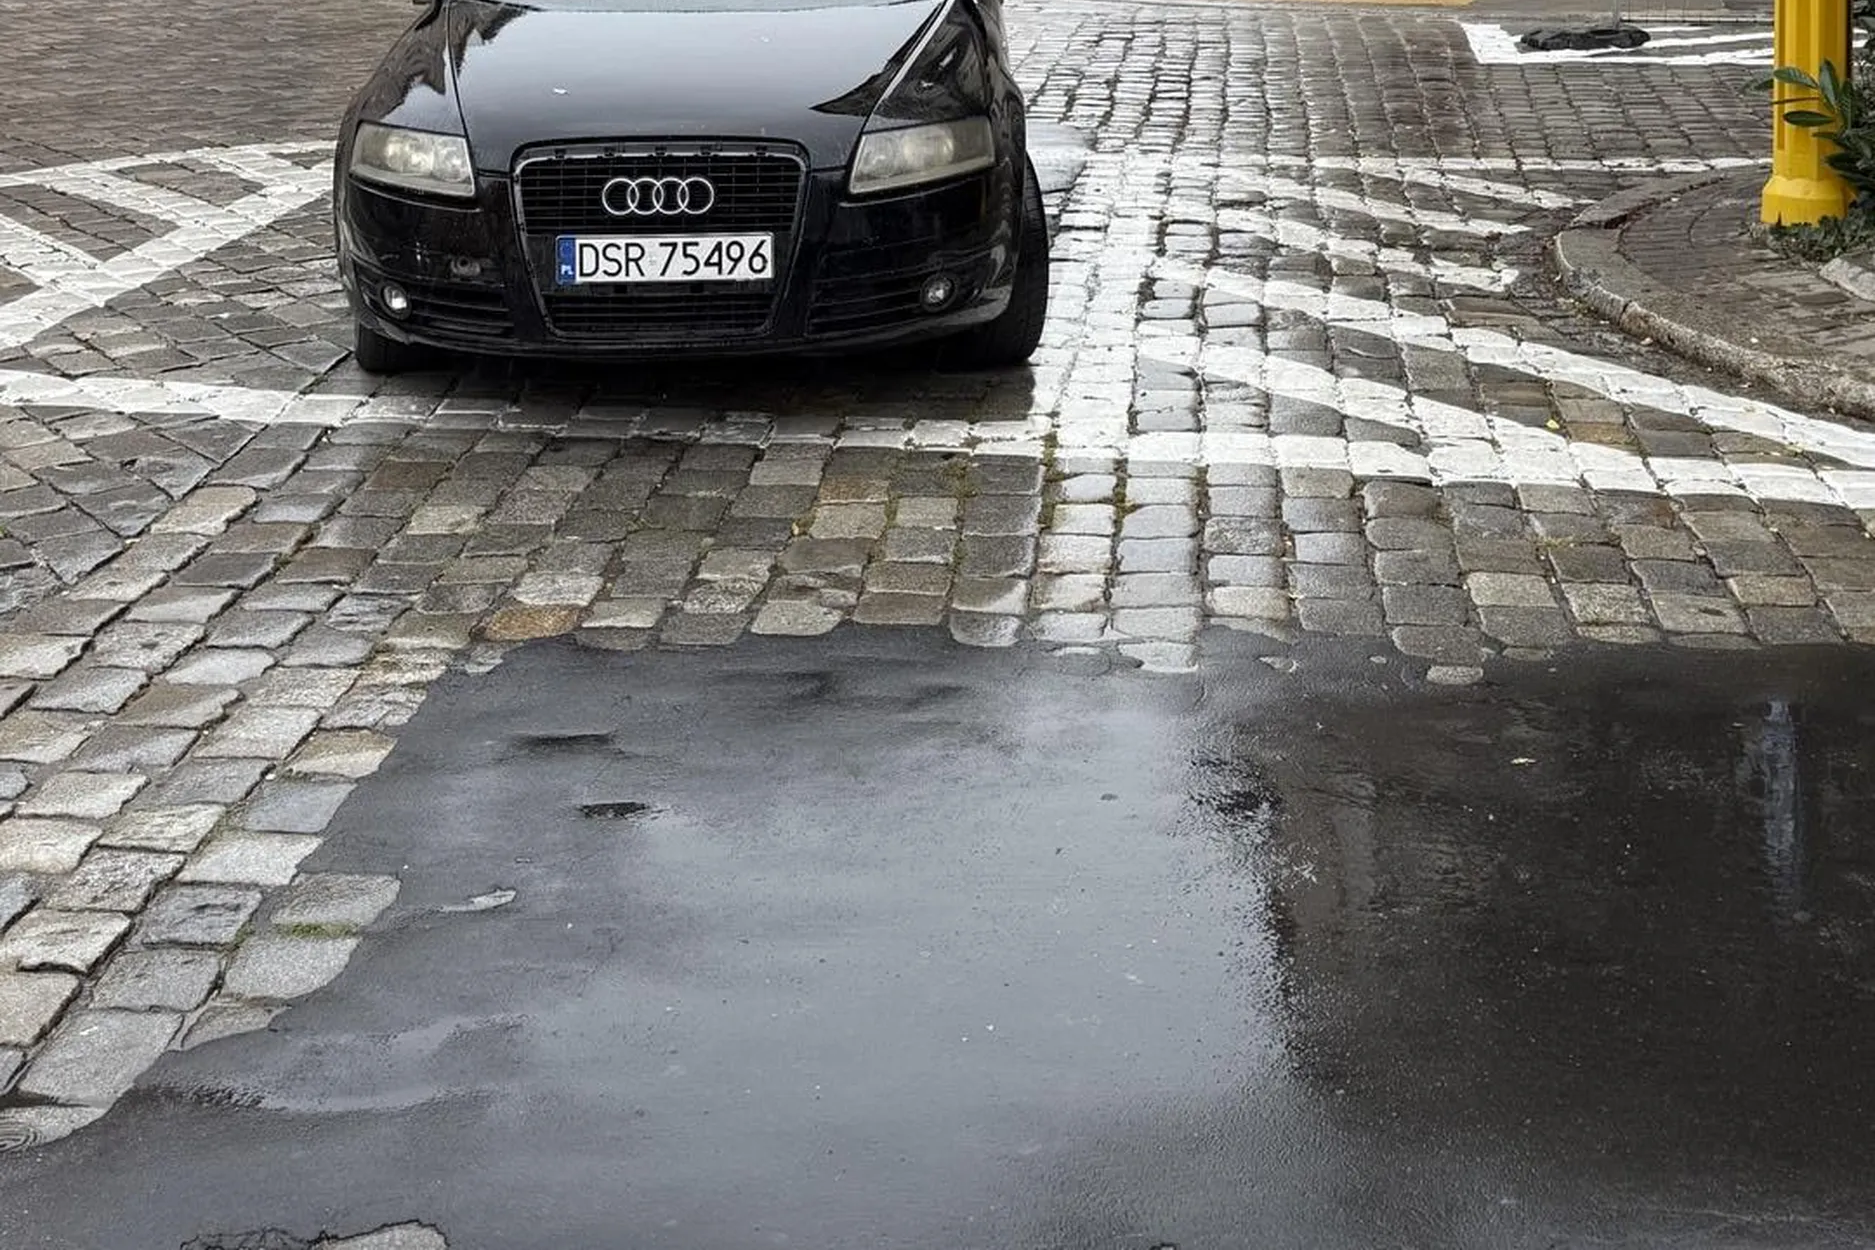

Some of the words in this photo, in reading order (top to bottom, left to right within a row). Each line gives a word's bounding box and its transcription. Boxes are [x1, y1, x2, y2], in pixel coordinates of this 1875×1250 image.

[560, 264, 574, 276] PL
[578, 242, 645, 277] DSR
[659, 239, 768, 276] 75496
